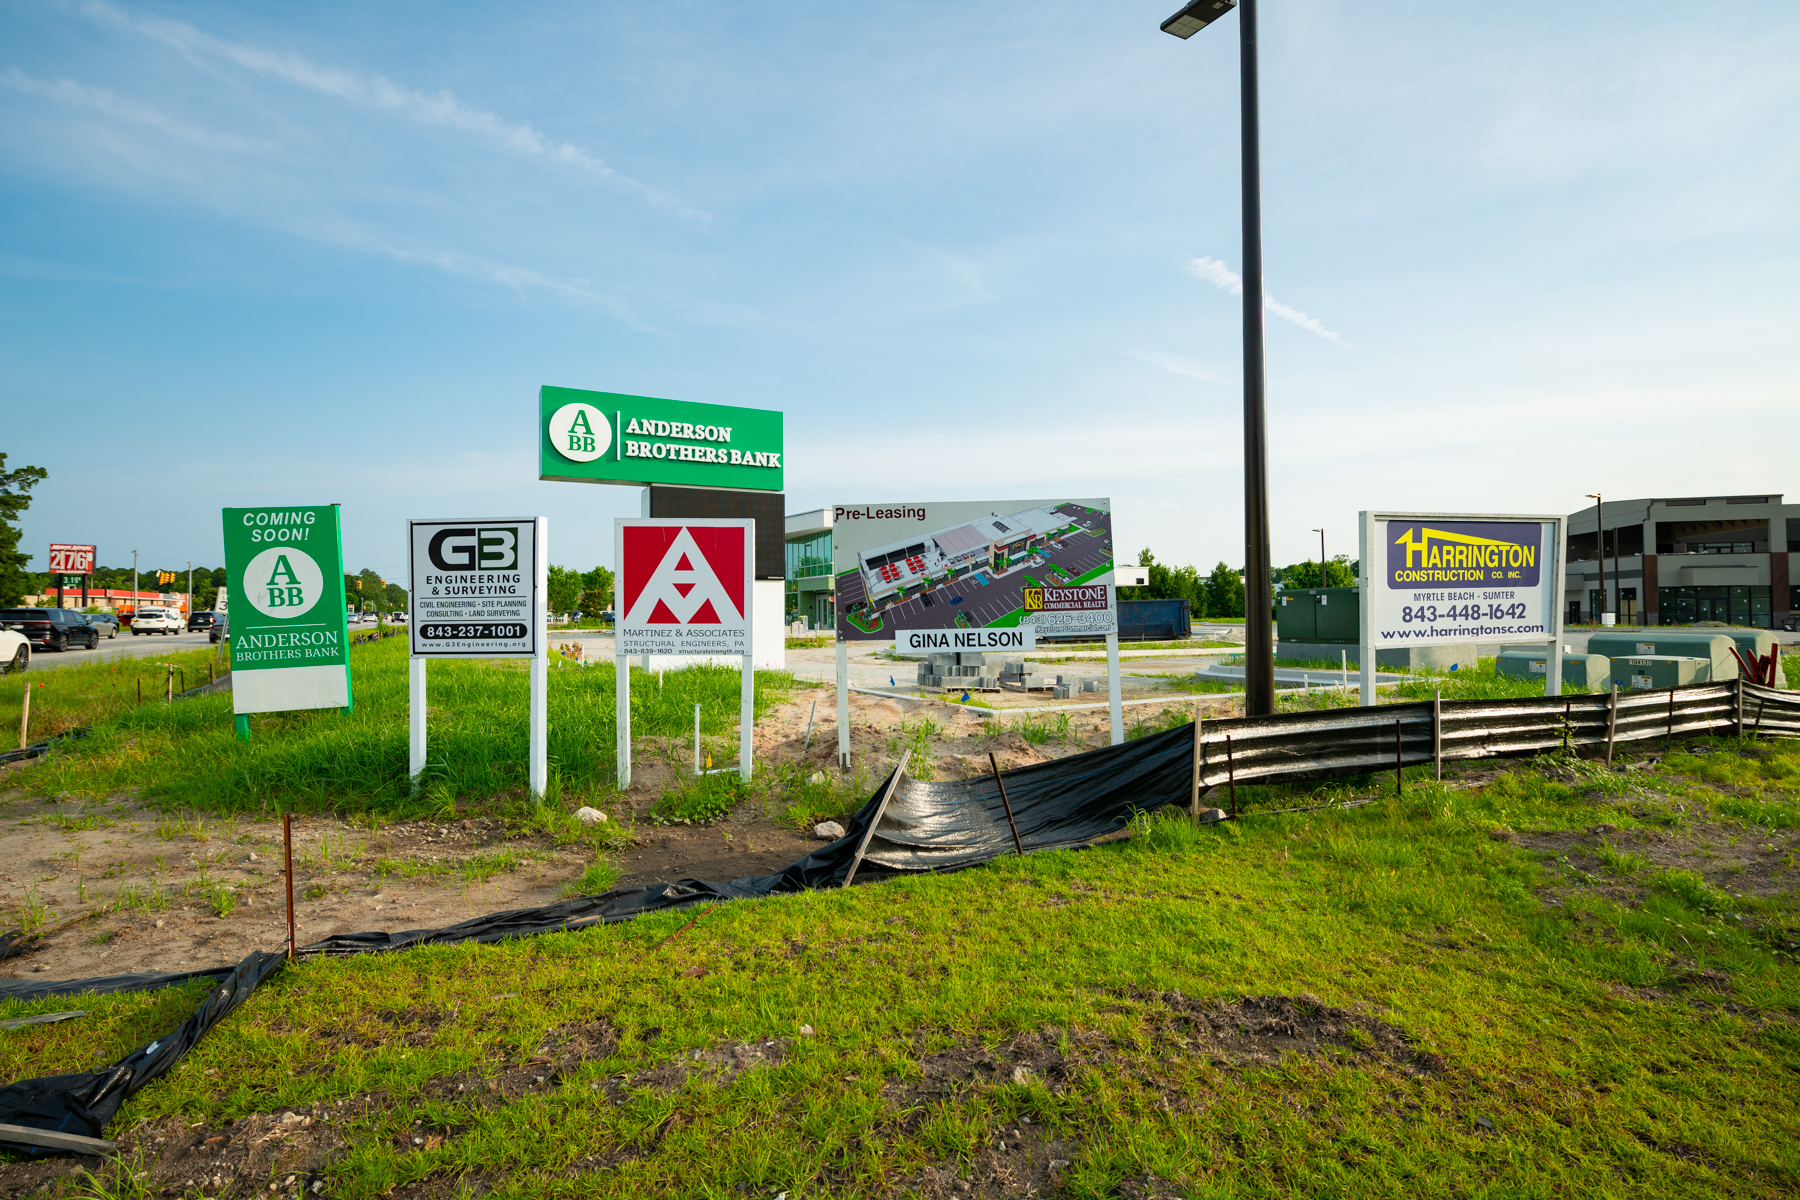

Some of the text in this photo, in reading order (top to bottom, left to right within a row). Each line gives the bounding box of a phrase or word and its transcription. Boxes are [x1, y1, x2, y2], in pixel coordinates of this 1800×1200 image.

[568, 409, 595, 436] A
[626, 418, 732, 443] ANDERSON
[567, 434, 596, 453] BB
[626, 440, 782, 468] BROTHERS BANK
[243, 511, 316, 526] COMING
[835, 505, 926, 521] Pre-Leasing
[251, 528, 310, 542] SOON!
[1394, 527, 1536, 568] HARRINGTON
[266, 554, 301, 586] A
[1395, 569, 1522, 582] CONSTRUCTION CO. INC.
[426, 573, 521, 585] ENGINEERING
[267, 586, 304, 607] BB
[432, 585, 517, 595] & SURVEYING
[1043, 586, 1106, 602] KEYSTONE
[1413, 592, 1445, 602] MYRTLE
[1447, 591, 1475, 601] BEACH
[1482, 591, 1515, 600] SUMTER
[420, 600, 527, 609] CIVIL ENGINEERING SITE PLANNING
[1043, 600, 1106, 610] COMMERCIAL REALTY
[426, 609, 521, 618] CONSULTING LAND SURVEYING
[1019, 611, 1113, 626] (843) 626-3400
[1402, 602, 1527, 623] 843-448-1642
[427, 625, 521, 638] 843-237-1001
[623, 628, 745, 637] MARTINEZ & ASSOCIATES
[1381, 625, 1544, 639] www.harringtonsc.com
[236, 631, 338, 649] ANDERSON
[680, 640, 730, 648] ENGINEERS,
[909, 631, 1023, 648] GINA NELSON
[236, 647, 339, 662] BROTHERS BANK
